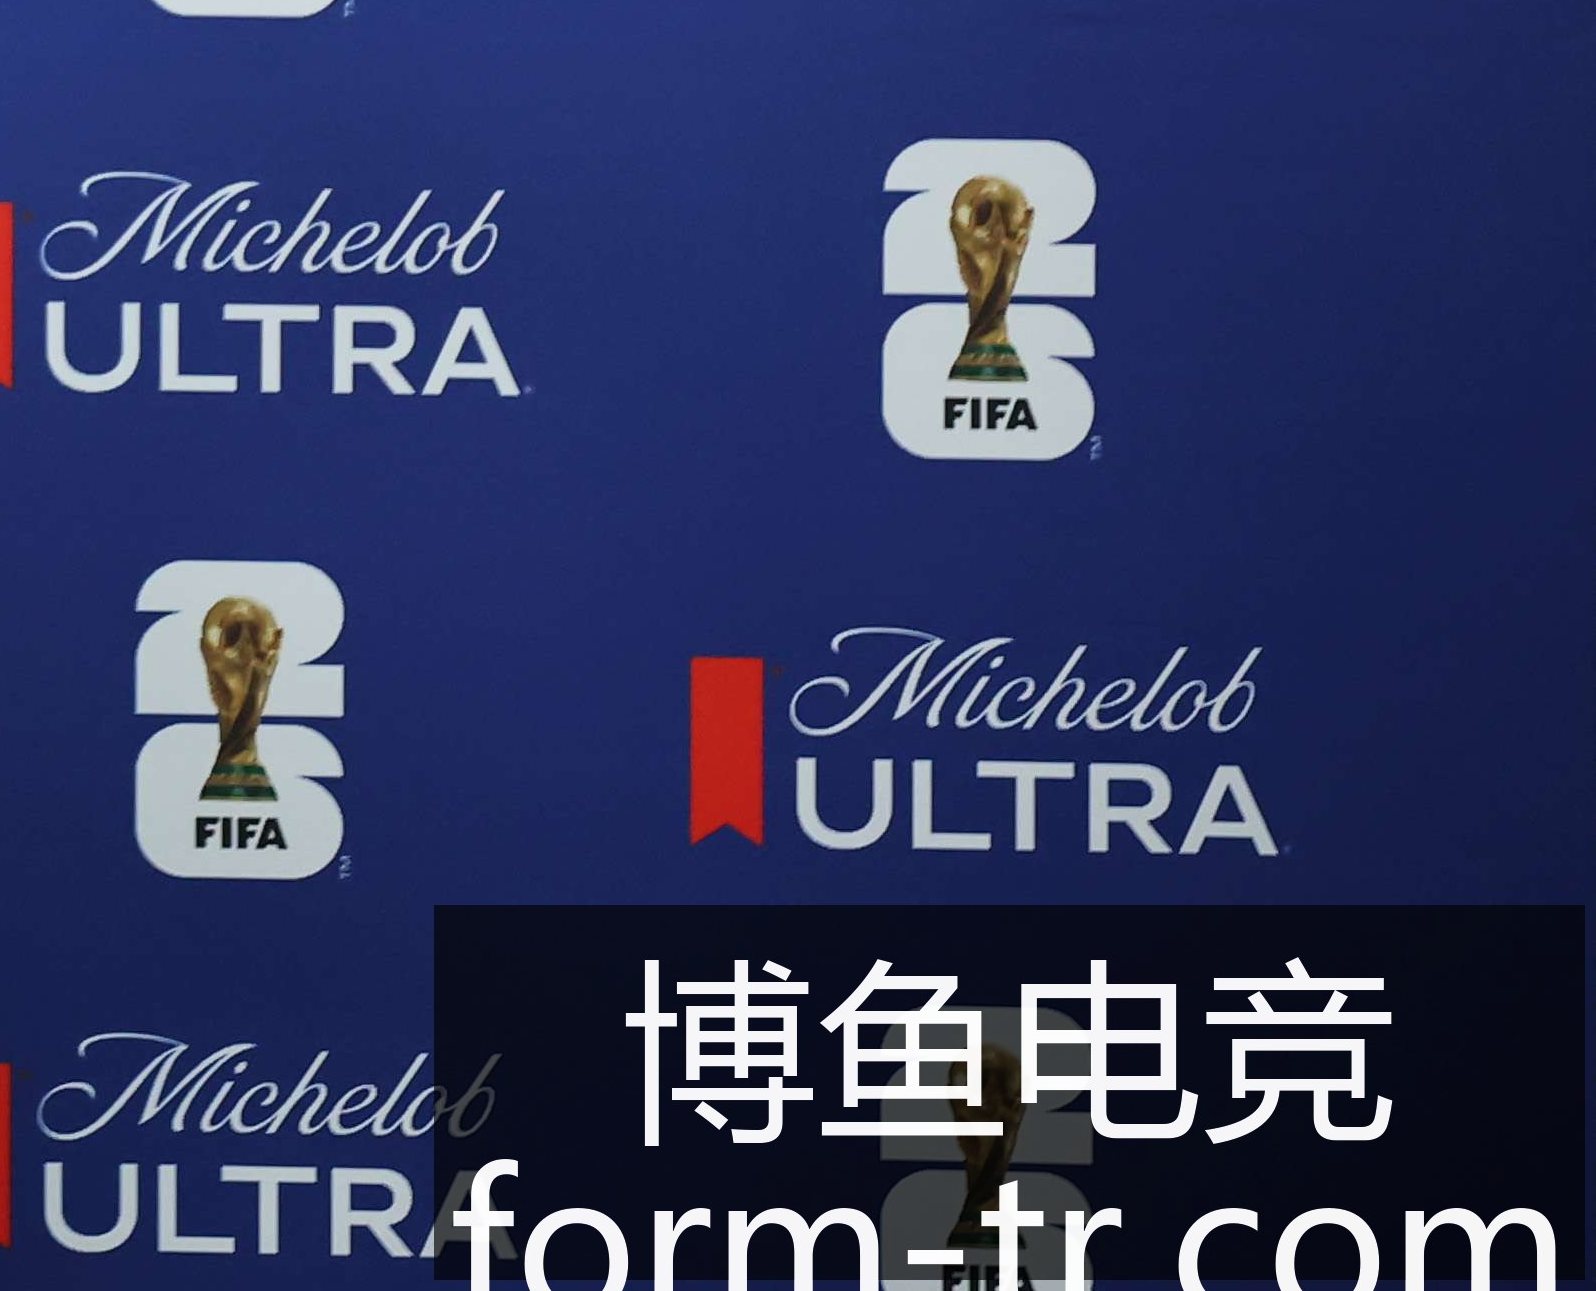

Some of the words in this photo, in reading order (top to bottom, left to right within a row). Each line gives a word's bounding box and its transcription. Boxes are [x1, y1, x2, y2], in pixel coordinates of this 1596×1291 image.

[40, 172, 505, 280] Michelob
[46, 301, 520, 396] ULTRA
[944, 397, 1038, 431] FIFA
[790, 627, 1262, 736] Michelob
[195, 816, 288, 850] FIFA
[796, 757, 1278, 856] ULTRA
[40, 1033, 502, 1140] Michelob
